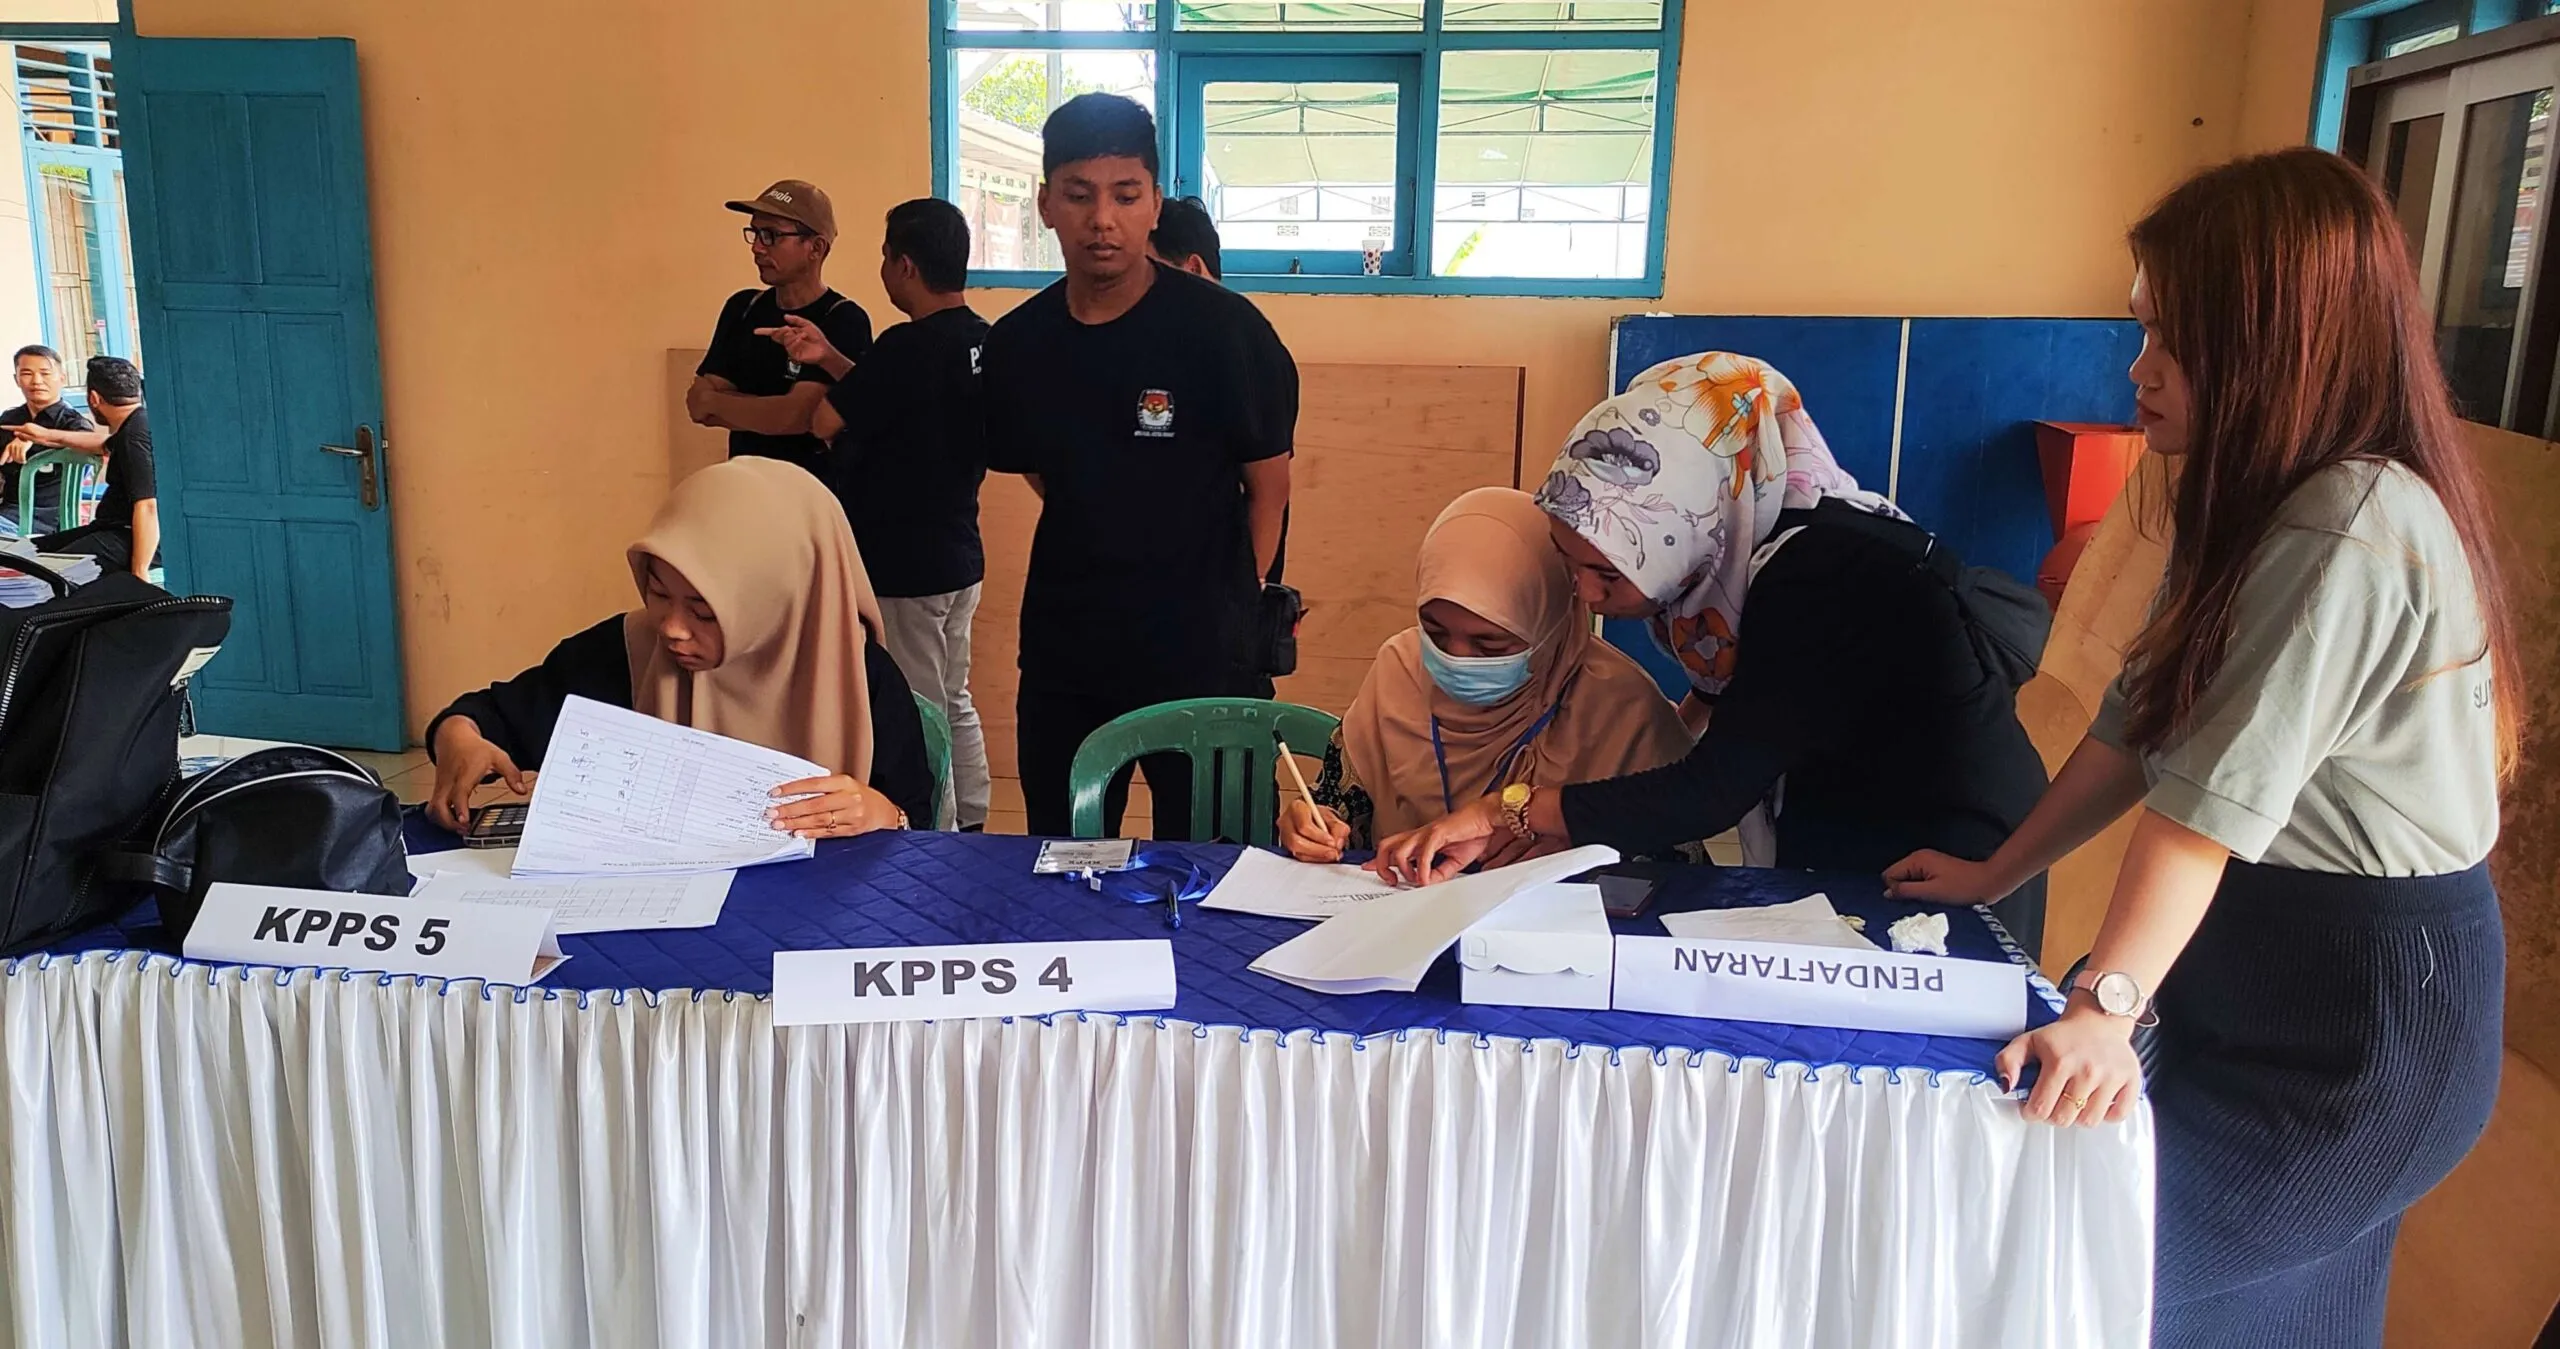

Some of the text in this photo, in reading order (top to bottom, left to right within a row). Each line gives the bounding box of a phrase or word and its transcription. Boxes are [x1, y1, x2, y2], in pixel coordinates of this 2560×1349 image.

[253, 906, 451, 956] KPPS 5
[853, 956, 1073, 997] KPPS 4
[1673, 947, 1944, 992] PENDAFTARAN
